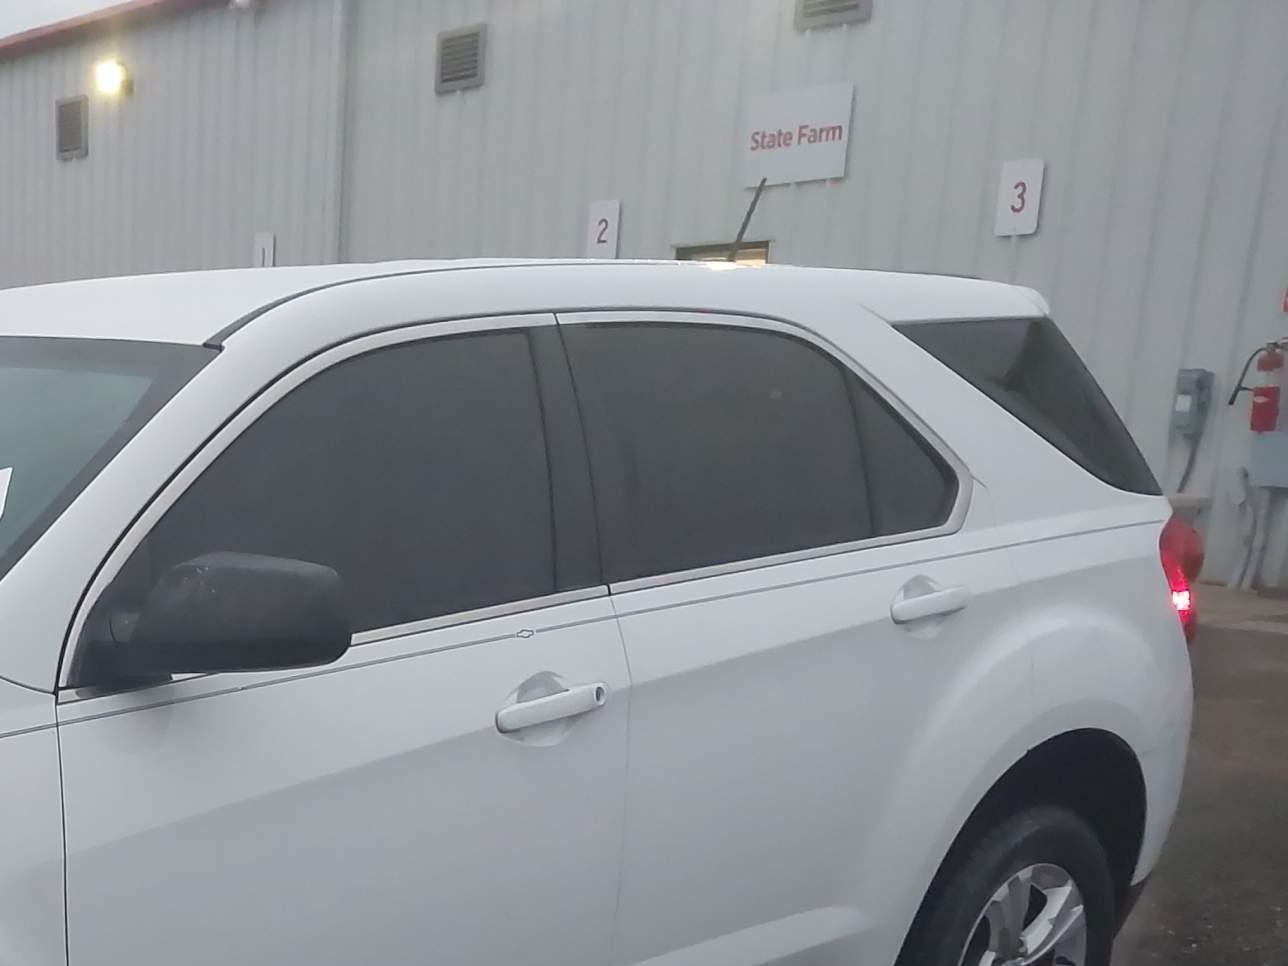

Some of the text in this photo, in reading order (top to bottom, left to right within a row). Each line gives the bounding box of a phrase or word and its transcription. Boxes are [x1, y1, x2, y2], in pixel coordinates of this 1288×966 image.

[749, 124, 843, 151] State Farm
[1010, 181, 1027, 213] 3
[596, 217, 609, 244] 2
